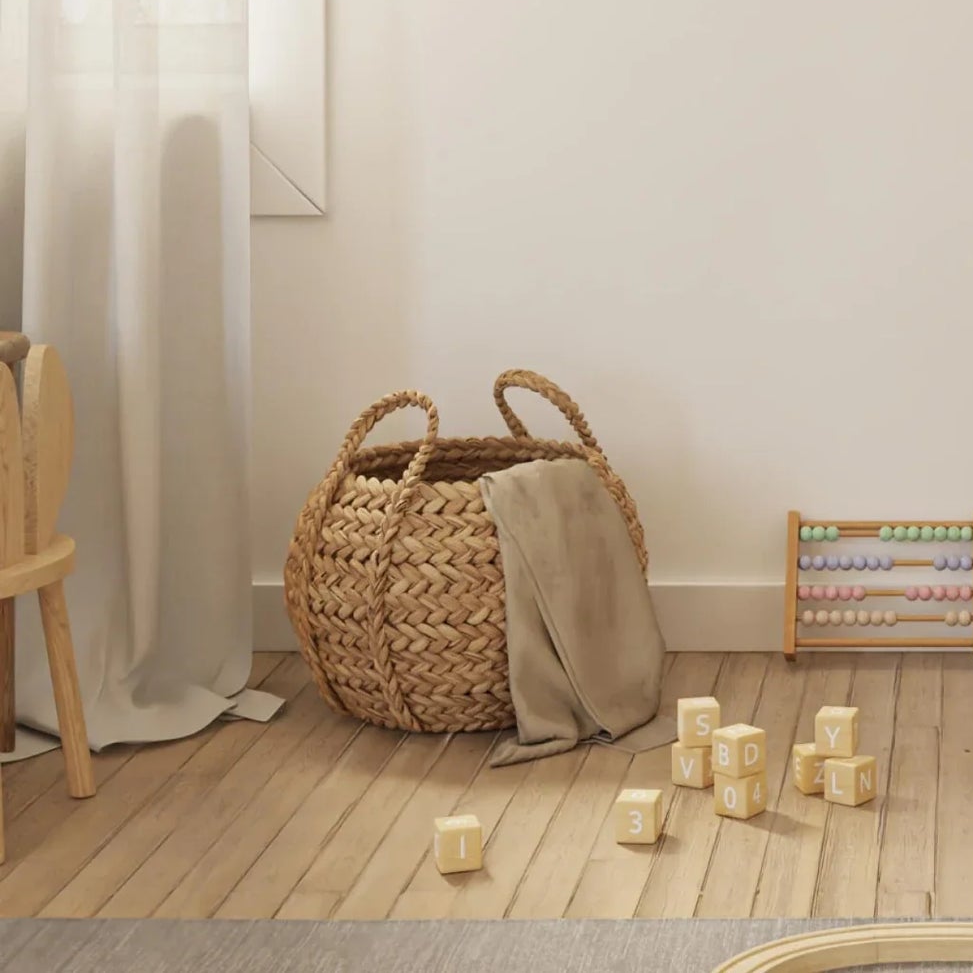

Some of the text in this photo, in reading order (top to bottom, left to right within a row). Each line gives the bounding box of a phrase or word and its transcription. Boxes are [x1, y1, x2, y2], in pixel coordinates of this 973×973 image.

[696, 714, 710, 736] S
[824, 726, 841, 749] Y
[718, 742, 730, 766] B
[744, 743, 759, 766] D
[680, 756, 695, 779] V
[831, 771, 844, 795] L
[860, 768, 872, 794] N
[628, 810, 643, 834] 3
